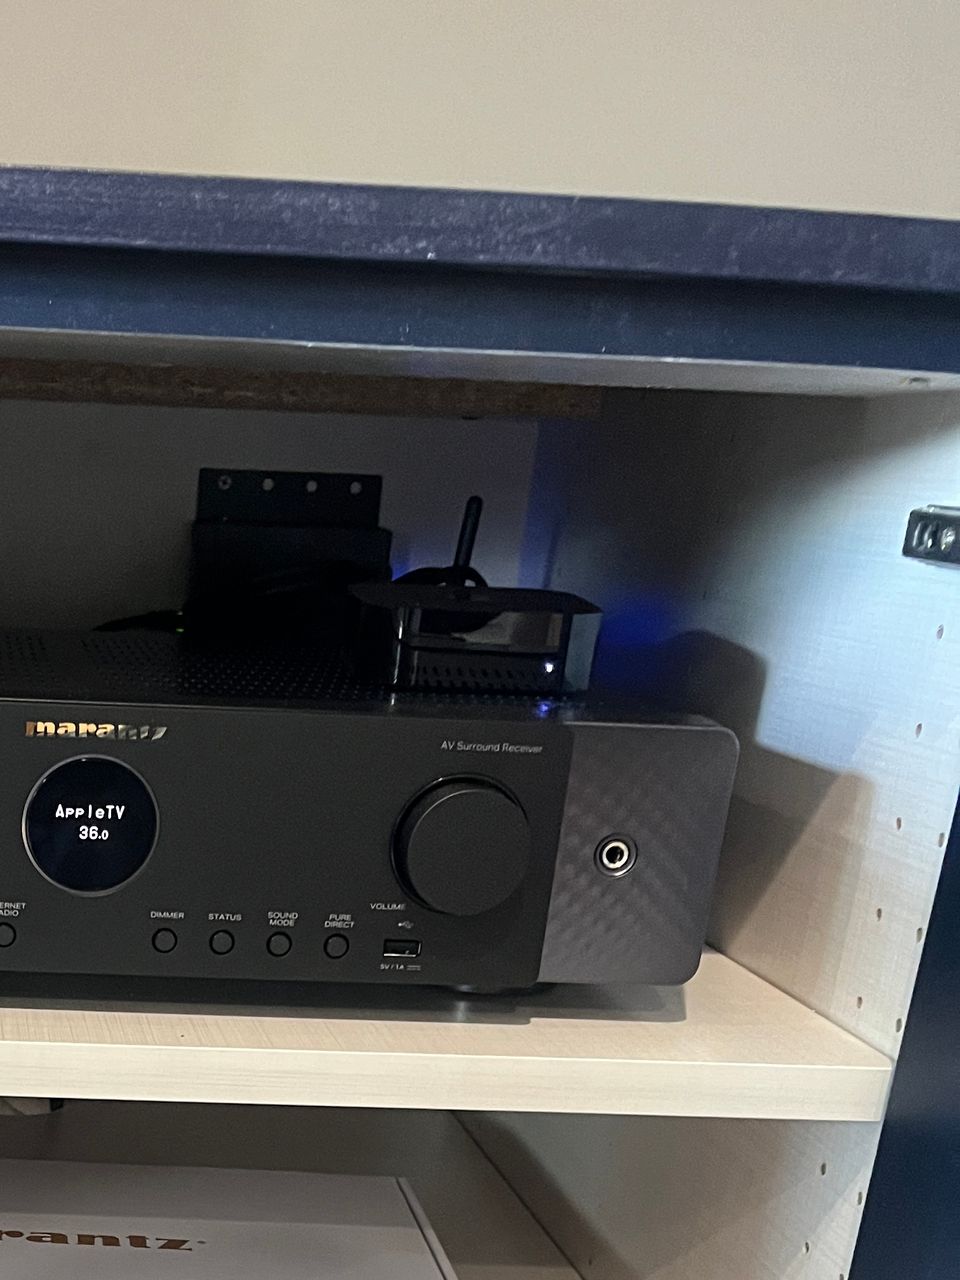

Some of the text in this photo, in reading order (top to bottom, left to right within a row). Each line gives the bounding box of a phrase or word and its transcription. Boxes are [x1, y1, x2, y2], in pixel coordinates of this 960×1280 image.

[440, 740, 543, 754] AV Surround Receiver
[55, 803, 126, 820] AppleTV
[78, 825, 110, 841] 36.0
[369, 903, 407, 911] VOLUME
[150, 910, 185, 920] DIMMER
[208, 913, 243, 922] STATUS
[267, 911, 299, 920] SOUND
[328, 913, 352, 922] PURE
[269, 918, 295, 927] MODE
[324, 920, 355, 929] DIRECT
